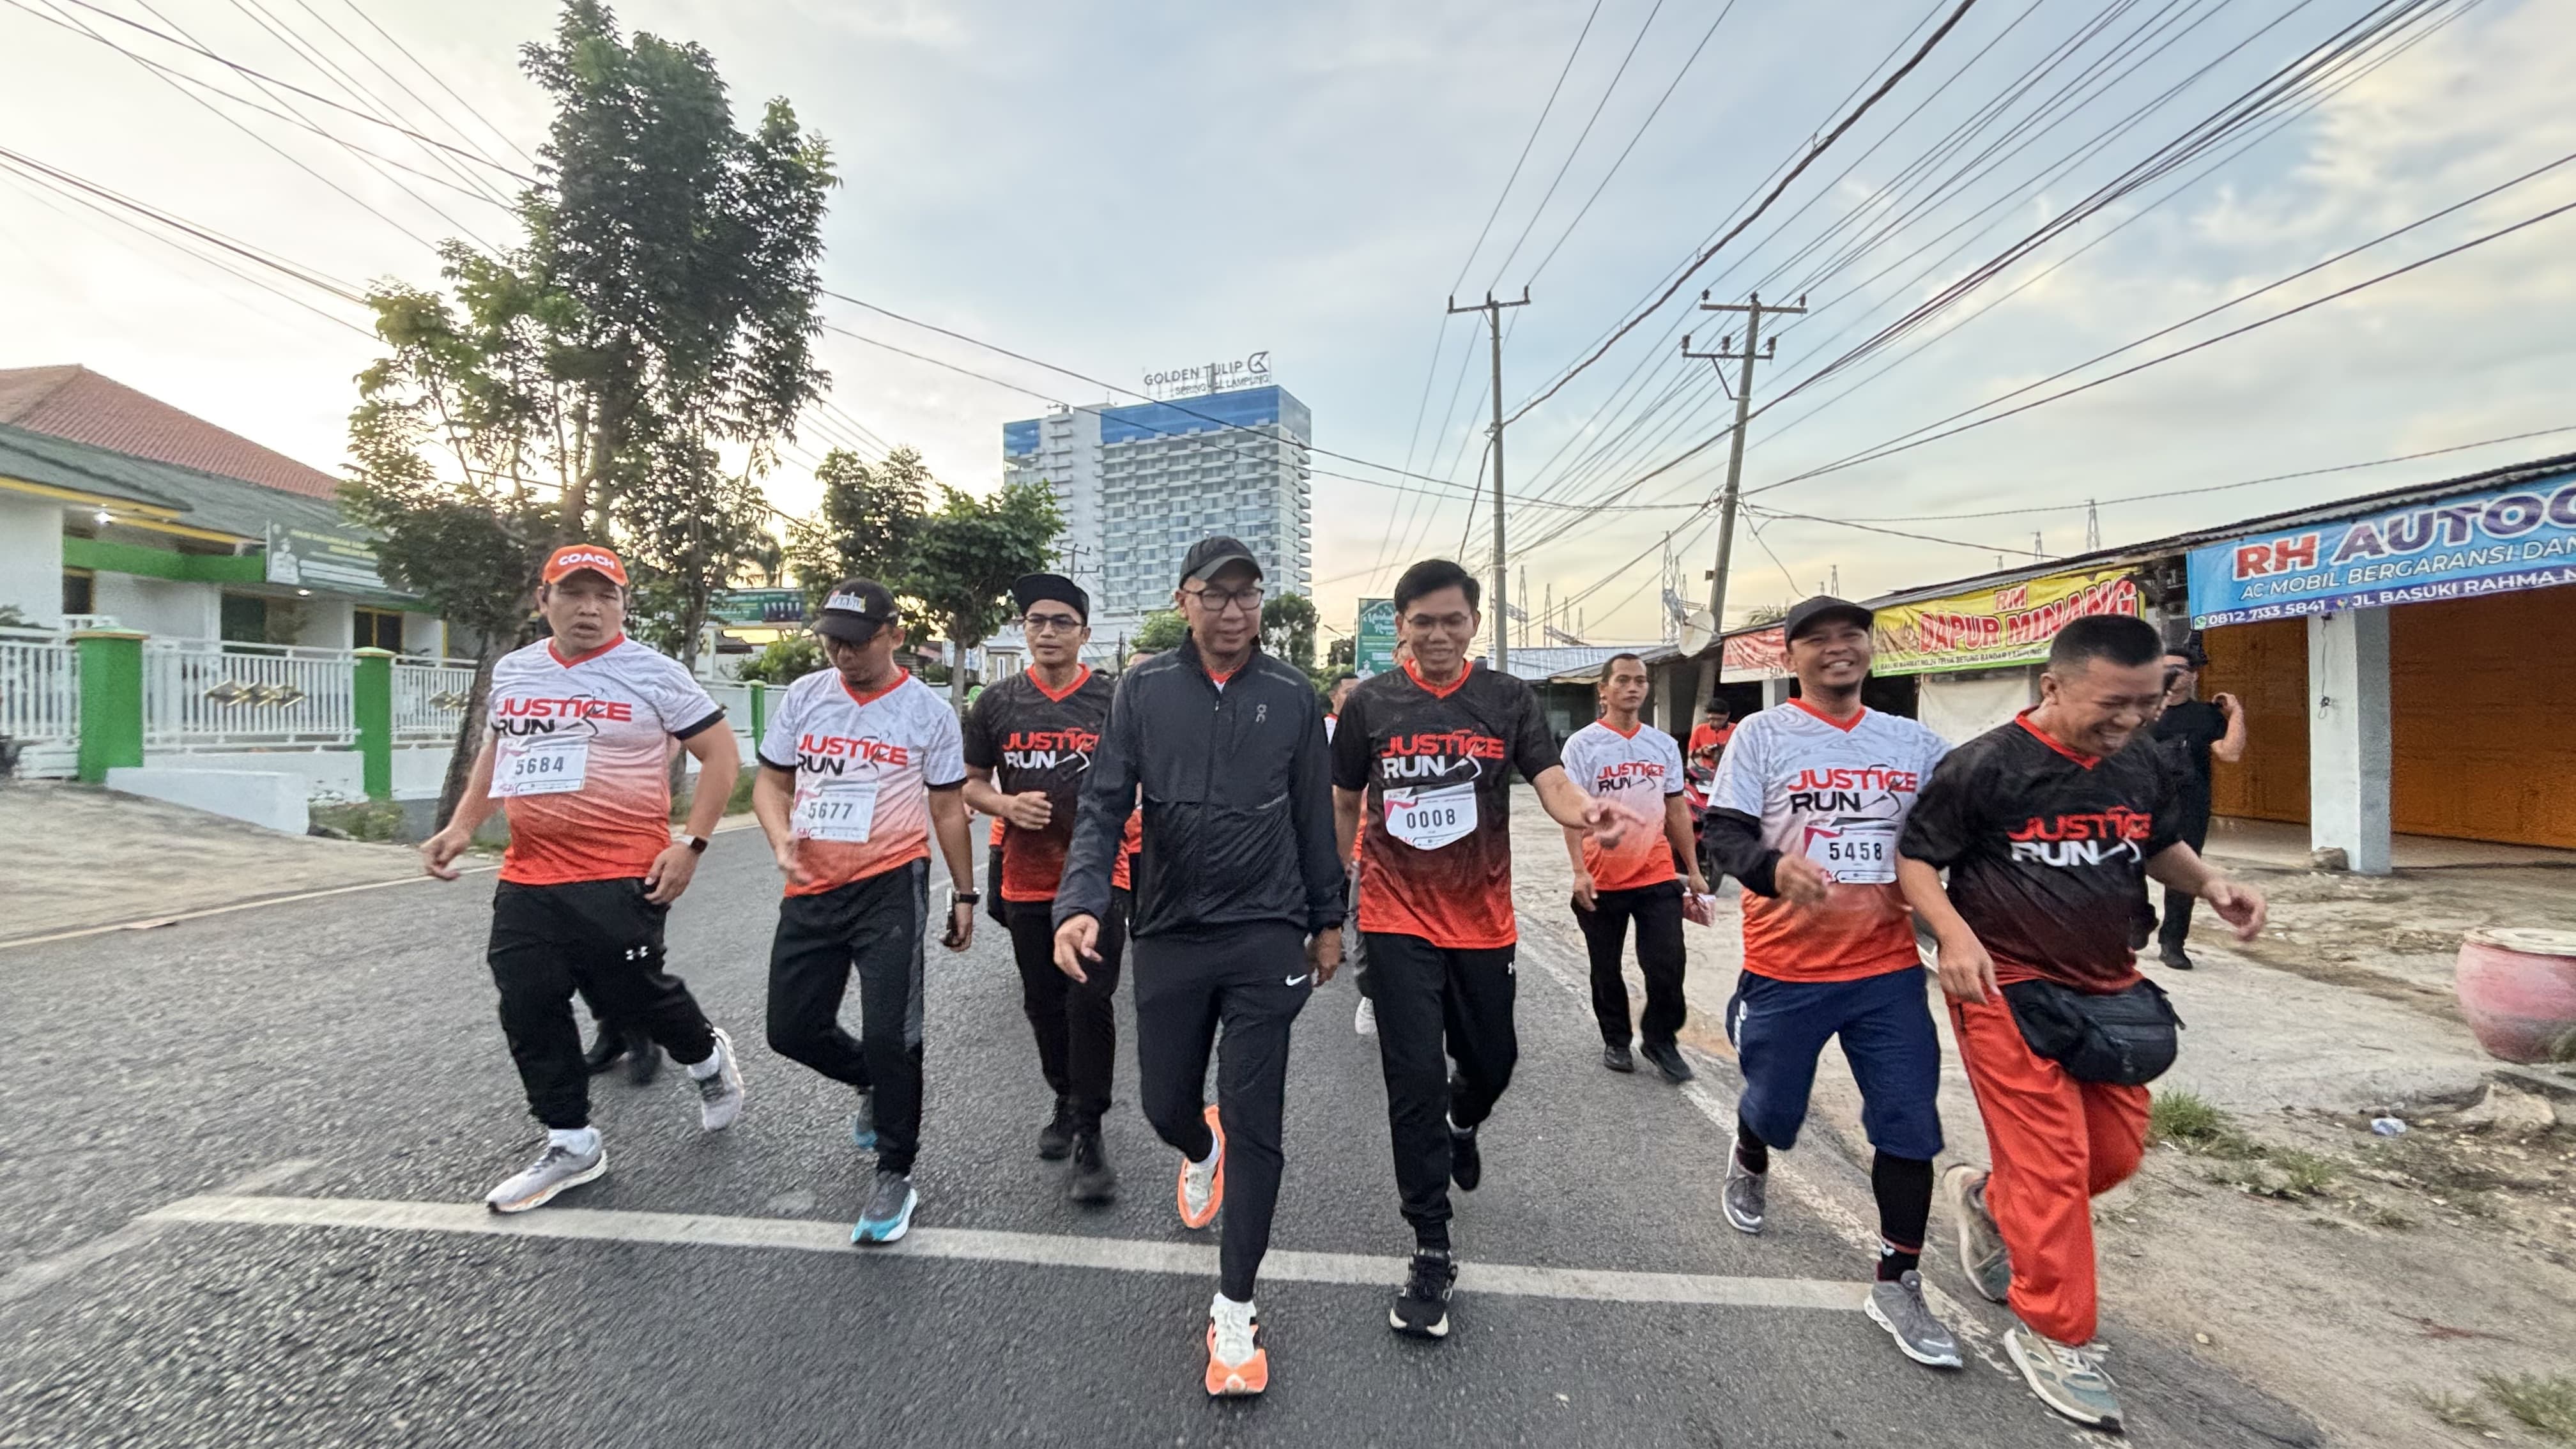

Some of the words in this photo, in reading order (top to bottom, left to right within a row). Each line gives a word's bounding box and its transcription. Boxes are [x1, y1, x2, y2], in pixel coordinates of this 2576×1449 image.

[1144, 367, 1199, 386] GOLDEN
[1204, 361, 1243, 378] TULIP
[558, 553, 615, 569] COACH
[2234, 534, 2319, 579] RH
[2239, 583, 2264, 600] AC
[2270, 571, 2340, 595] MOBIL
[2347, 546, 2513, 585] BERGARANSI
[1994, 584, 2028, 612] RM
[2208, 611, 2246, 625] 0812
[2285, 600, 2326, 614] 5841
[2352, 594, 2375, 606] JL
[2379, 583, 2458, 604] BASUKI
[1919, 611, 2002, 654] DAPUR
[2006, 574, 2139, 647] MINANG
[498, 698, 632, 722] JUSTICE
[491, 717, 555, 735] RUN
[799, 733, 908, 765] JUSTICE
[1381, 733, 1505, 759] JUSTICE
[515, 756, 564, 775] 5684
[797, 753, 845, 776] RUN
[1004, 750, 1056, 769] RUN
[1381, 755, 1446, 779] RUN
[1597, 762, 1665, 779] JUSTICE
[1598, 777, 1631, 792] RUN
[1788, 769, 1917, 792] JUSTICE
[808, 802, 853, 820] 5677
[1790, 791, 1862, 815] RUN
[1406, 808, 1455, 829] 0008
[1829, 842, 1882, 861] 5458
[2010, 839, 2101, 867] RUN
